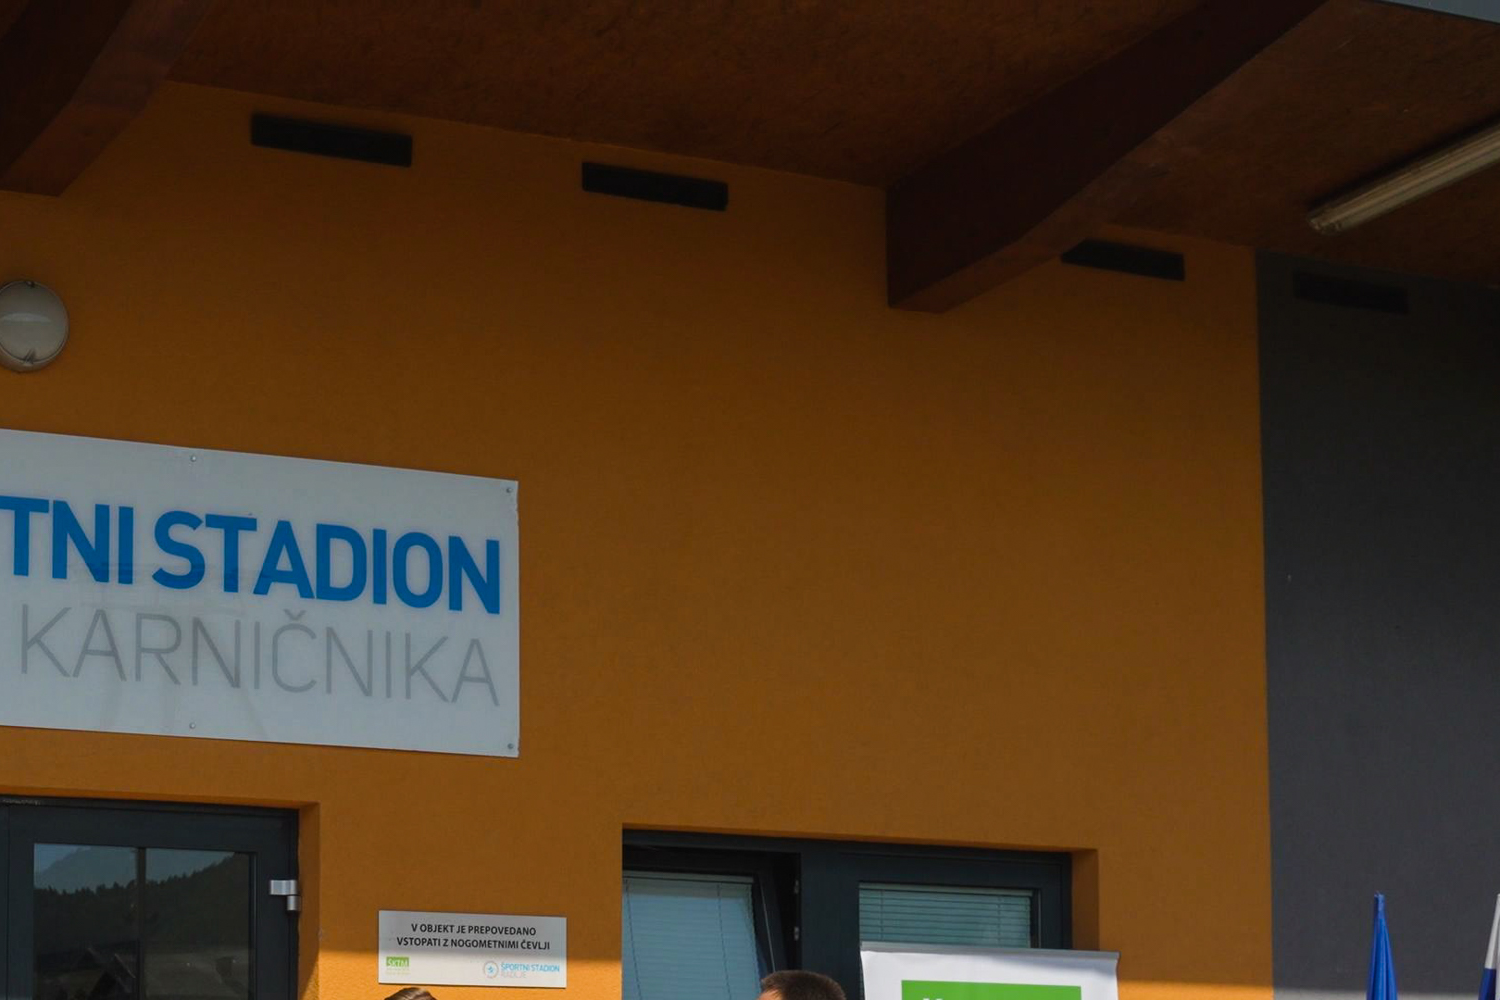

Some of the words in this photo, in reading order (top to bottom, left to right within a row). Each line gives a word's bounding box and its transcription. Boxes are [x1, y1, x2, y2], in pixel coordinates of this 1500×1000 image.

[151, 509, 502, 616] STADION
[18, 603, 501, 708] KARNIČNIKA
[396, 937, 441, 947] VSTOPATI
[443, 938, 449, 947] Z
[450, 938, 519, 949] NOGOMETNIMI
[520, 939, 550, 950] ČEVLJI
[411, 923, 418, 932] V
[419, 924, 454, 933] OBJEKT
[456, 925, 466, 934] JE
[467, 925, 537, 936] PREPOVEDANO
